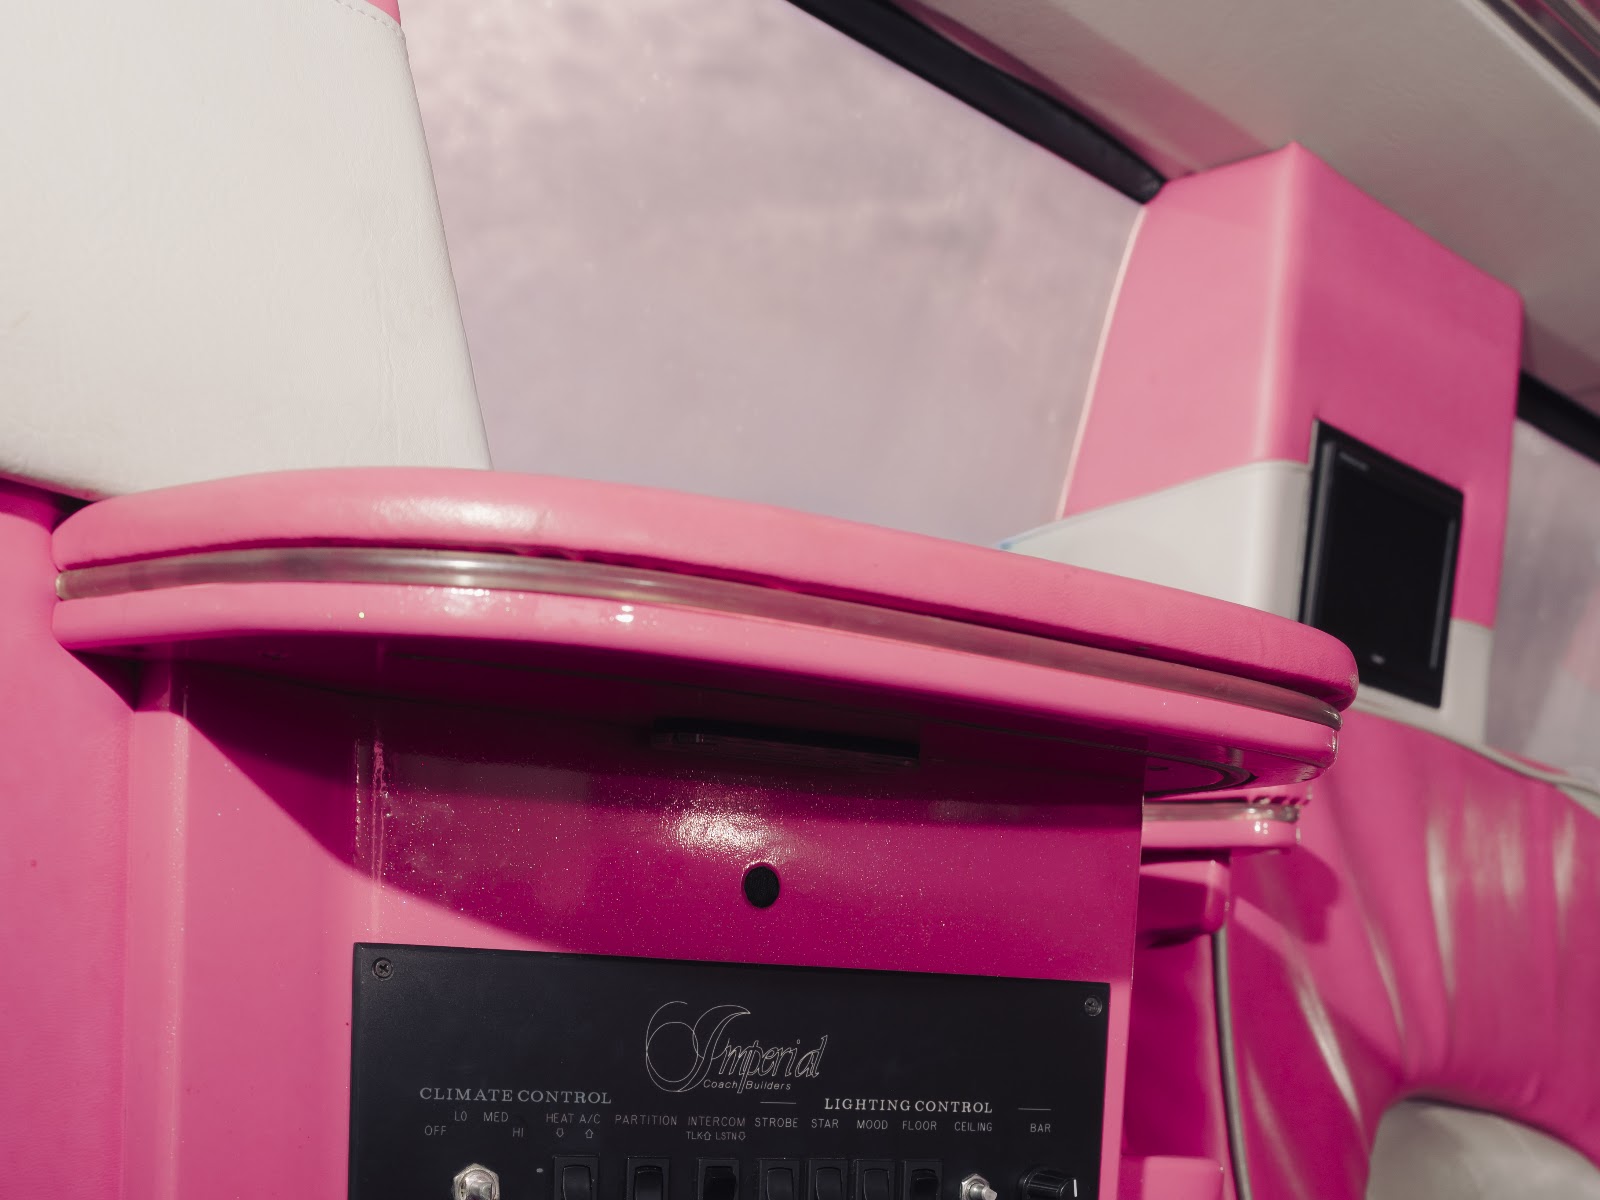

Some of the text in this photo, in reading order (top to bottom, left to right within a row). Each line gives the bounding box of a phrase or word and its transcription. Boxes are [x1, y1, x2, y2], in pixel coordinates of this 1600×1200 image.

[646, 1000, 828, 1094] Imperial
[703, 1079, 792, 1091] Coach Builders
[419, 1087, 612, 1104] CLIMATE CONTROL
[824, 1097, 993, 1114] LIGHTING CONTROL
[454, 1110, 468, 1122] LO
[483, 1111, 509, 1123] MED
[546, 1113, 601, 1124] HEAT A/C
[615, 1114, 678, 1126] PARTITION
[687, 1116, 746, 1127] INTERCOM
[754, 1117, 799, 1128] STROBE
[811, 1118, 839, 1129] STAR
[856, 1119, 888, 1130] MOOD
[902, 1120, 937, 1131] FLOOR
[954, 1121, 993, 1132] CEILING
[1030, 1123, 1051, 1133] BAR
[424, 1125, 447, 1136] OFF
[512, 1127, 524, 1138] HI
[715, 1131, 737, 1141] LSTN
